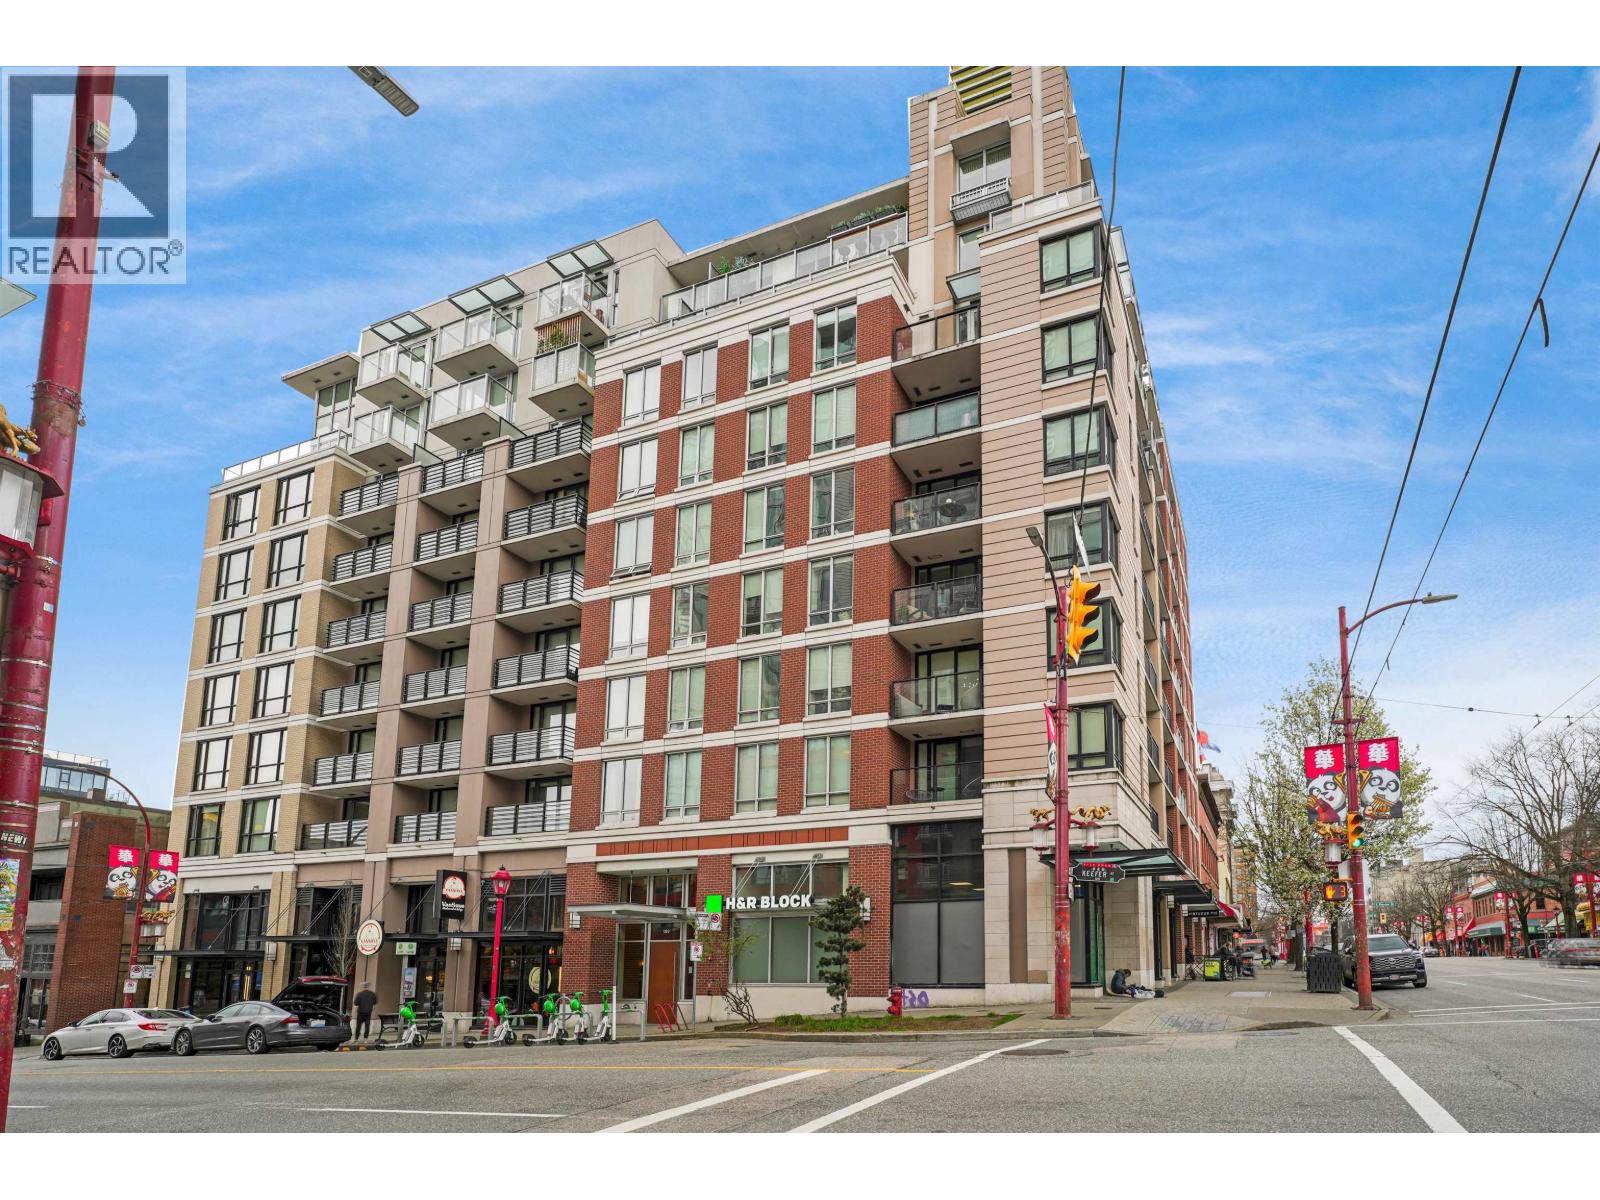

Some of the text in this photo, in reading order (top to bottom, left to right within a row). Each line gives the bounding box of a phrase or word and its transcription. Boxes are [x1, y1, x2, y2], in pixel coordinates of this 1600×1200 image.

[1081, 870, 1107, 878] KEEFER
[726, 894, 812, 909] H&R BLOCK
